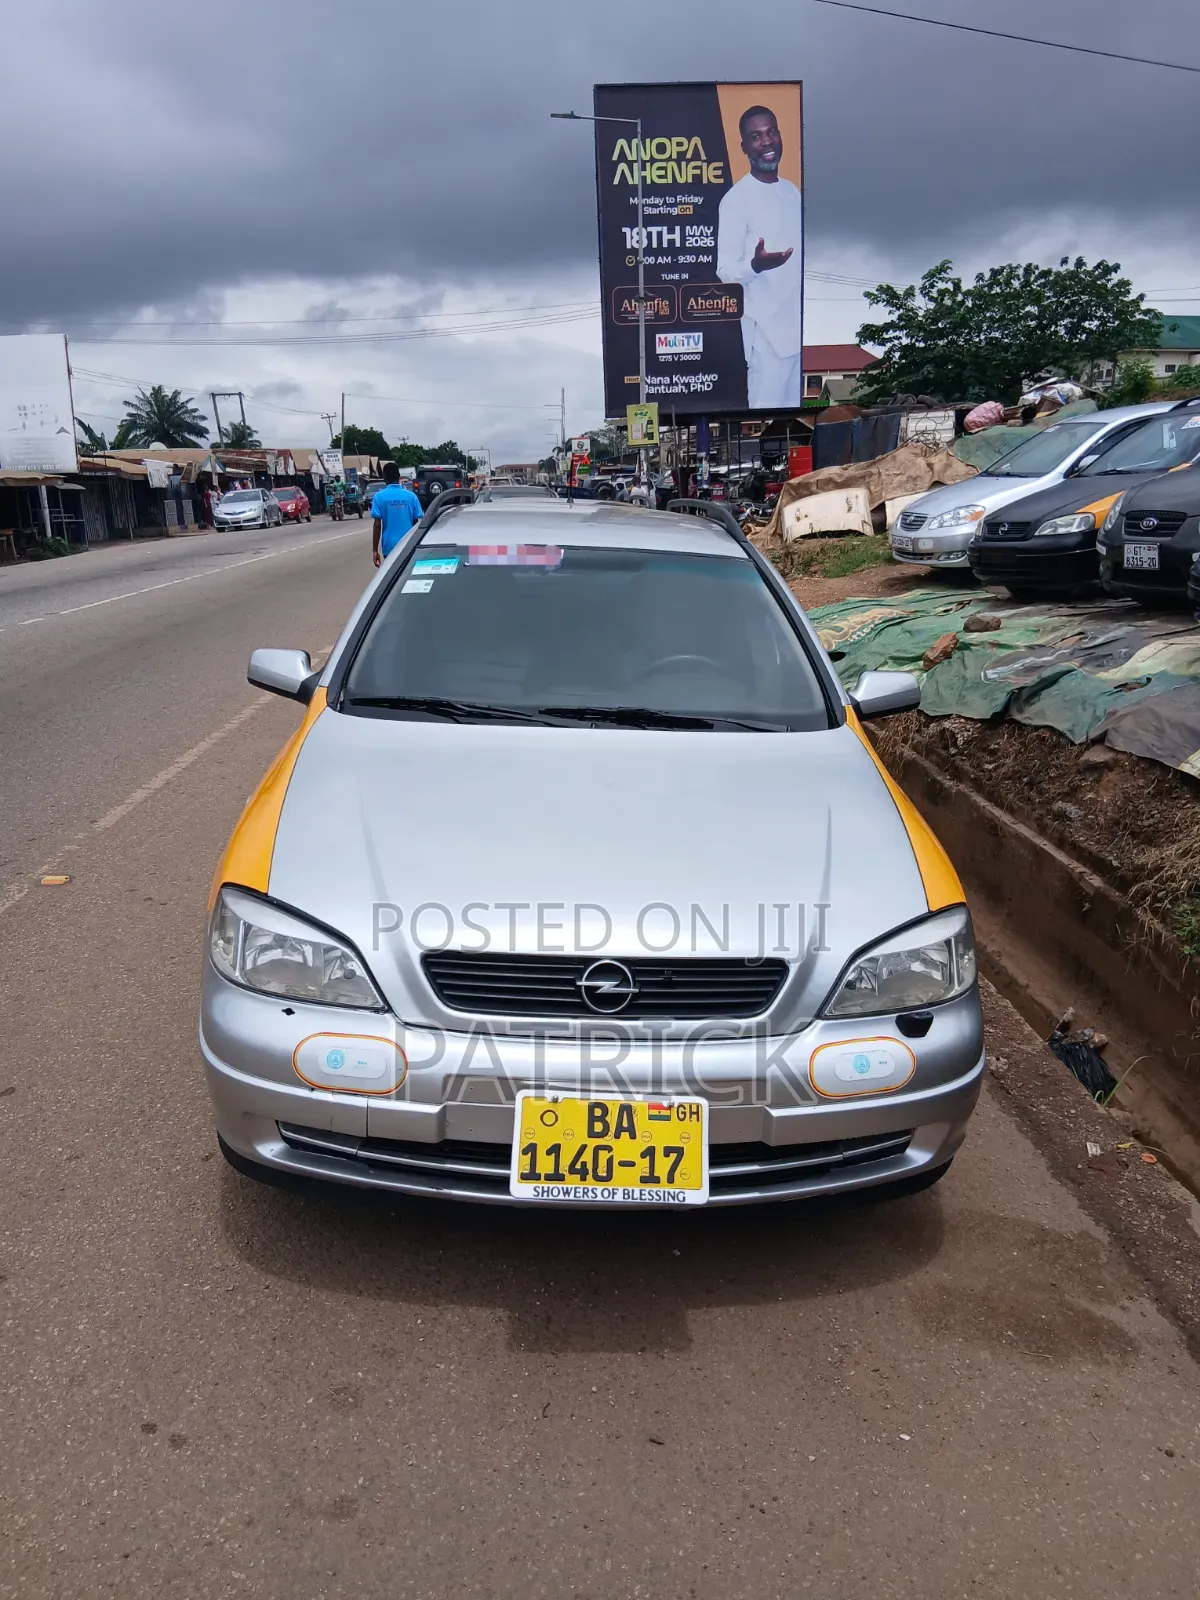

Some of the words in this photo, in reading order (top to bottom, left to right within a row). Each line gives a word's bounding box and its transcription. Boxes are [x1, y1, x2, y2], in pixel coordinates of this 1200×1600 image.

[612, 136, 706, 161] ANOPA
[612, 161, 724, 185] AHENFIE
[629, 195, 664, 206] Mnday
[665, 196, 675, 204] to
[676, 194, 704, 204] Friday
[643, 205, 678, 216] Starting
[621, 225, 681, 249] 18TH
[685, 225, 714, 237] MAY
[685, 236, 715, 248] 2026
[656, 255, 672, 265] AM
[677, 255, 696, 264] 9:30
[697, 255, 712, 263] AM
[687, 296, 737, 311] Ahenfie
[672, 373, 718, 383] Kwadwo
[690, 382, 713, 392] PhD
[1133, 545, 1142, 556] GT
[1125, 556, 1157, 568] 8315-20
[676, 1103, 700, 1123] GH
[587, 1101, 637, 1140] BA
[519, 1142, 685, 1184] 1140-17
[532, 1185, 598, 1200] SHOWERS
[600, 1187, 619, 1199] OF
[622, 1188, 686, 1203] BLESSING
